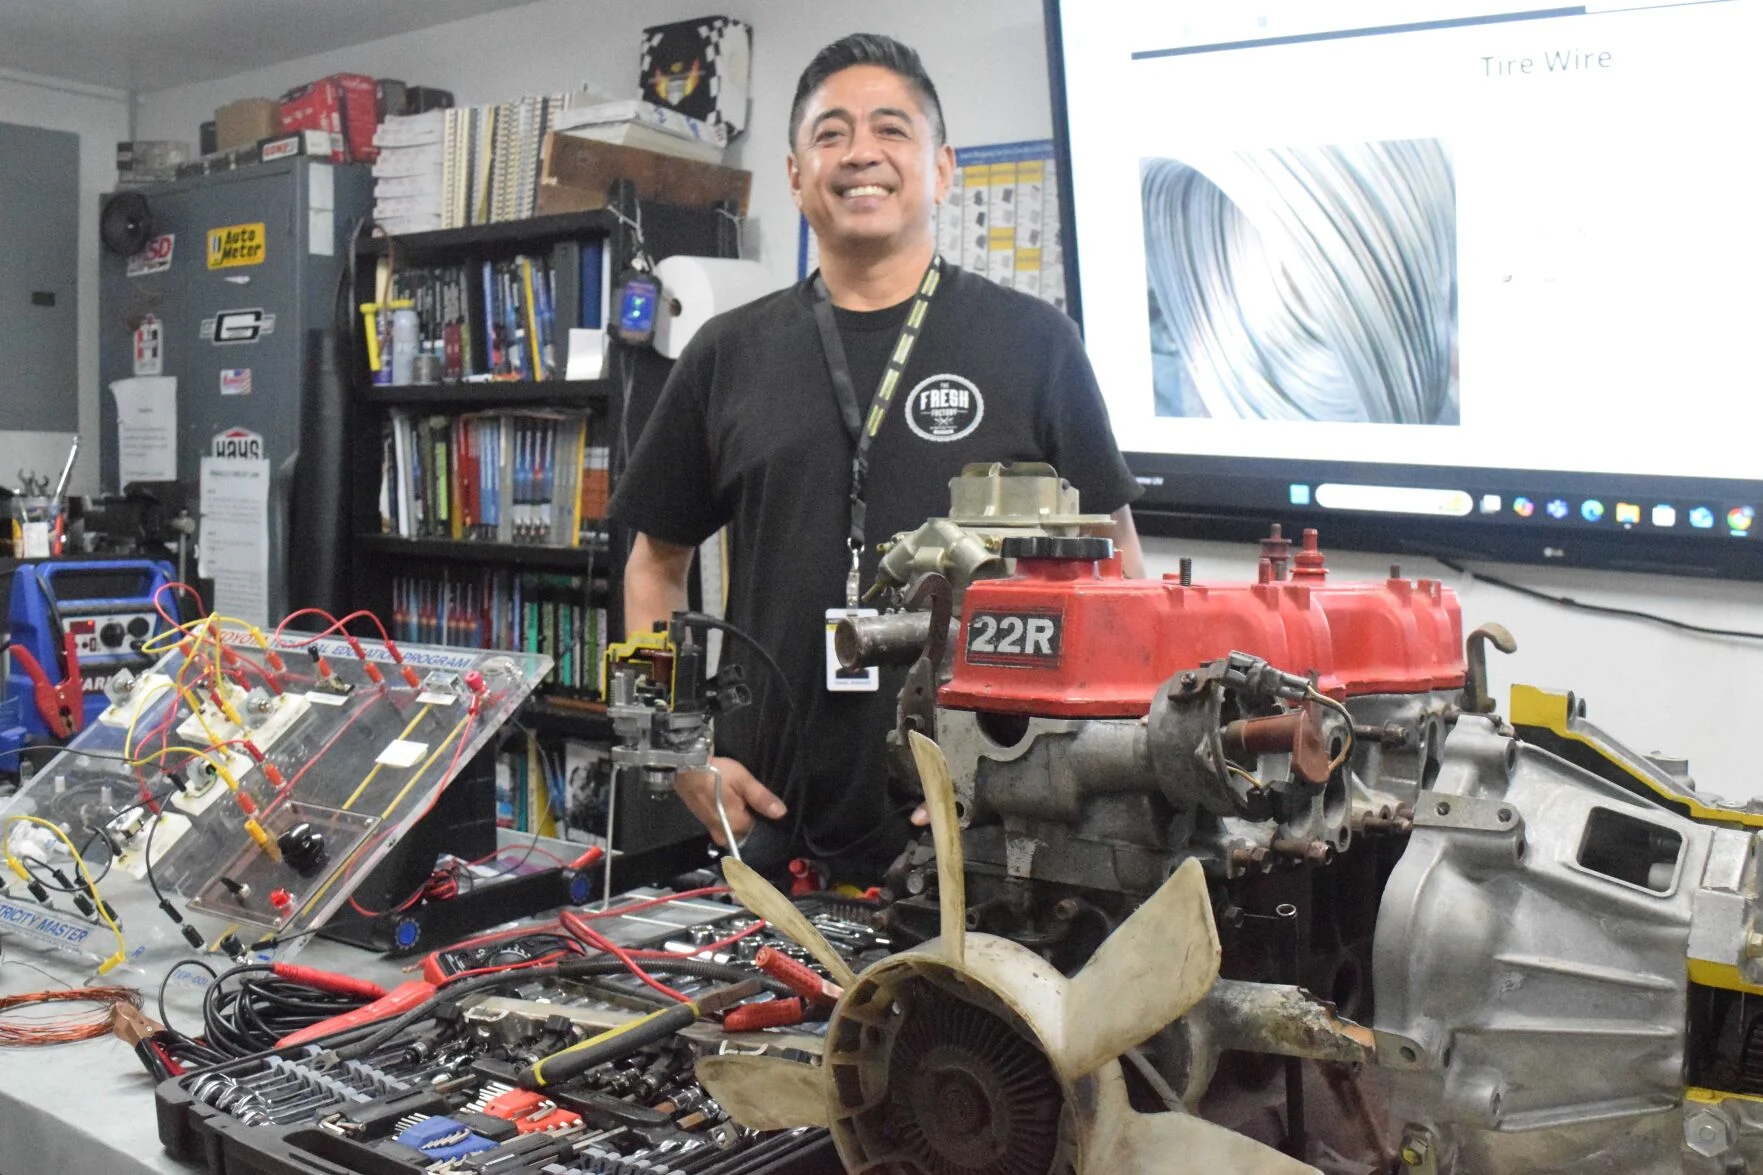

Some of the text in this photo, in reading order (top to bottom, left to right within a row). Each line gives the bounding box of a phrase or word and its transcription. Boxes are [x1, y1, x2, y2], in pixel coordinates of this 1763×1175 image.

[1480, 48, 1612, 77] Tire Wire
[225, 228, 256, 244] Auto
[224, 243, 262, 258] Meter
[920, 389, 970, 411] FRESH
[970, 615, 1055, 655] 22R
[403, 651, 471, 668] PROGRAM
[37, 918, 89, 943] MASTER
